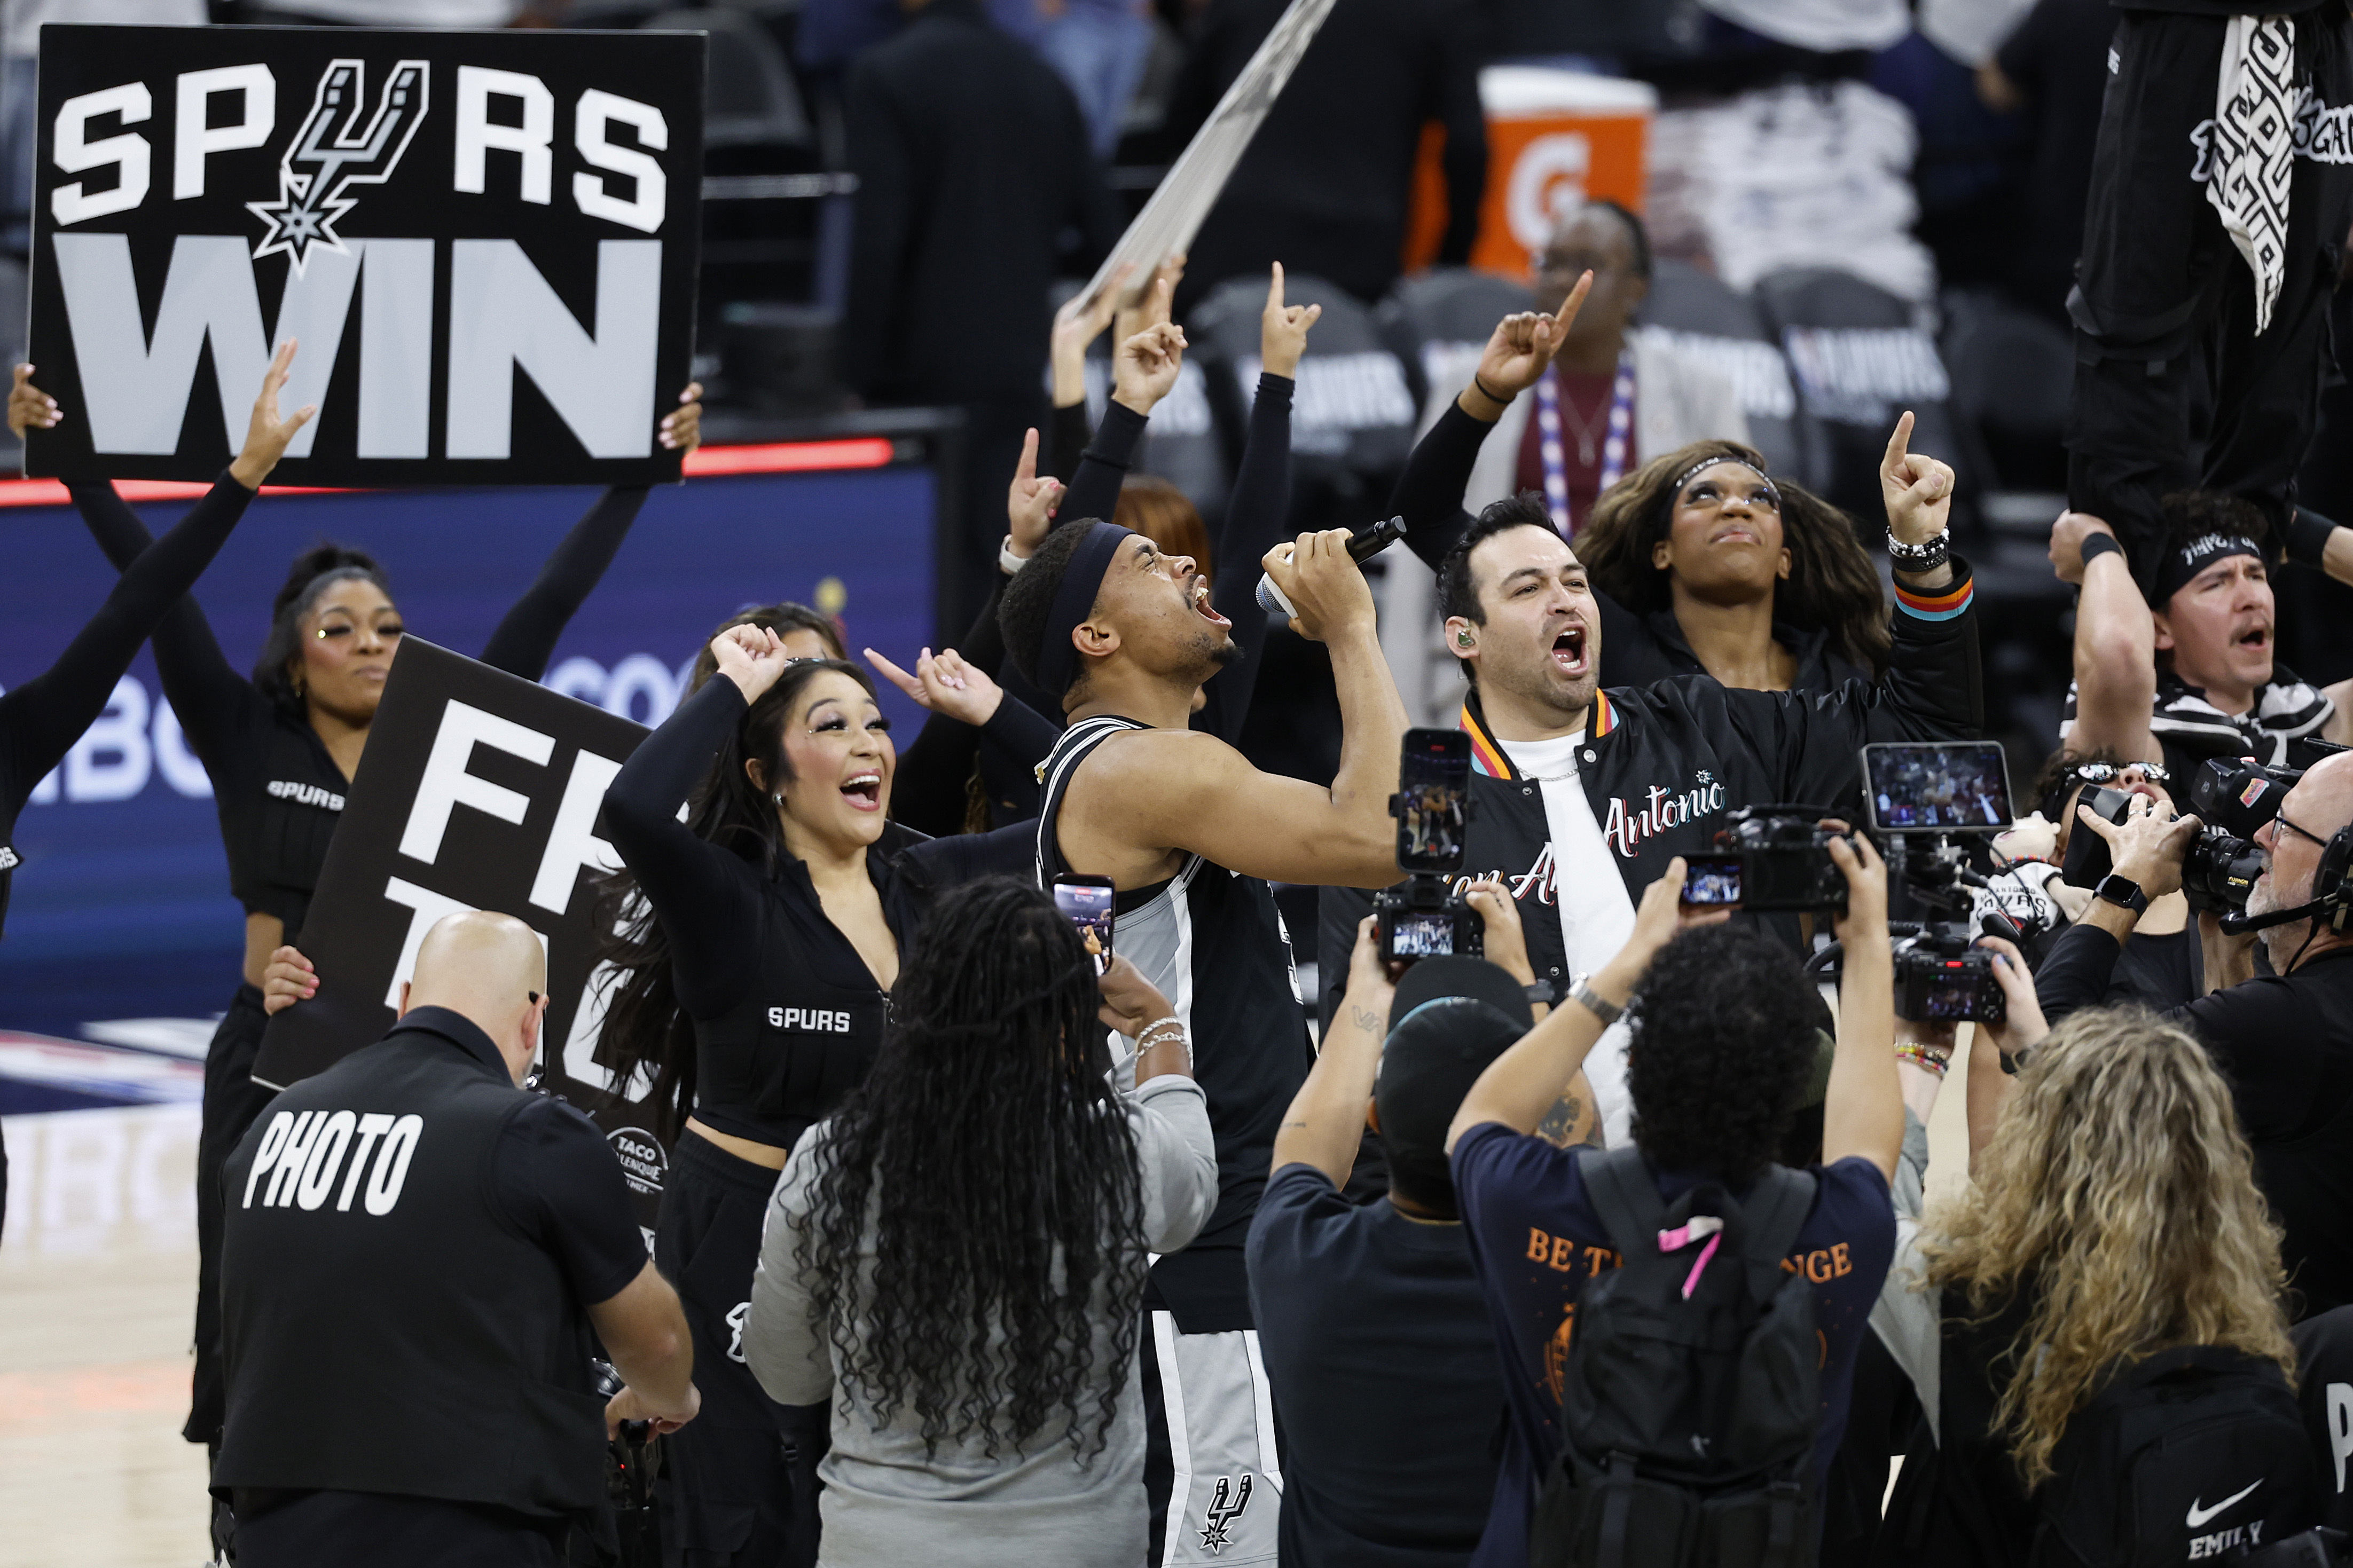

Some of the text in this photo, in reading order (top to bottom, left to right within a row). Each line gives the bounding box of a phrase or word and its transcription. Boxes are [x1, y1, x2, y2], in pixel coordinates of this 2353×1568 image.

[51, 58, 668, 280] SPURS
[52, 232, 663, 459] WIN
[267, 780, 346, 811] SPURS
[1603, 769, 1725, 858] Antonio
[768, 1007, 851, 1033] SPURS
[242, 1110, 424, 1216] PHOTO
[618, 1136, 656, 1162] TACO
[1526, 1227, 1573, 1272] BE
